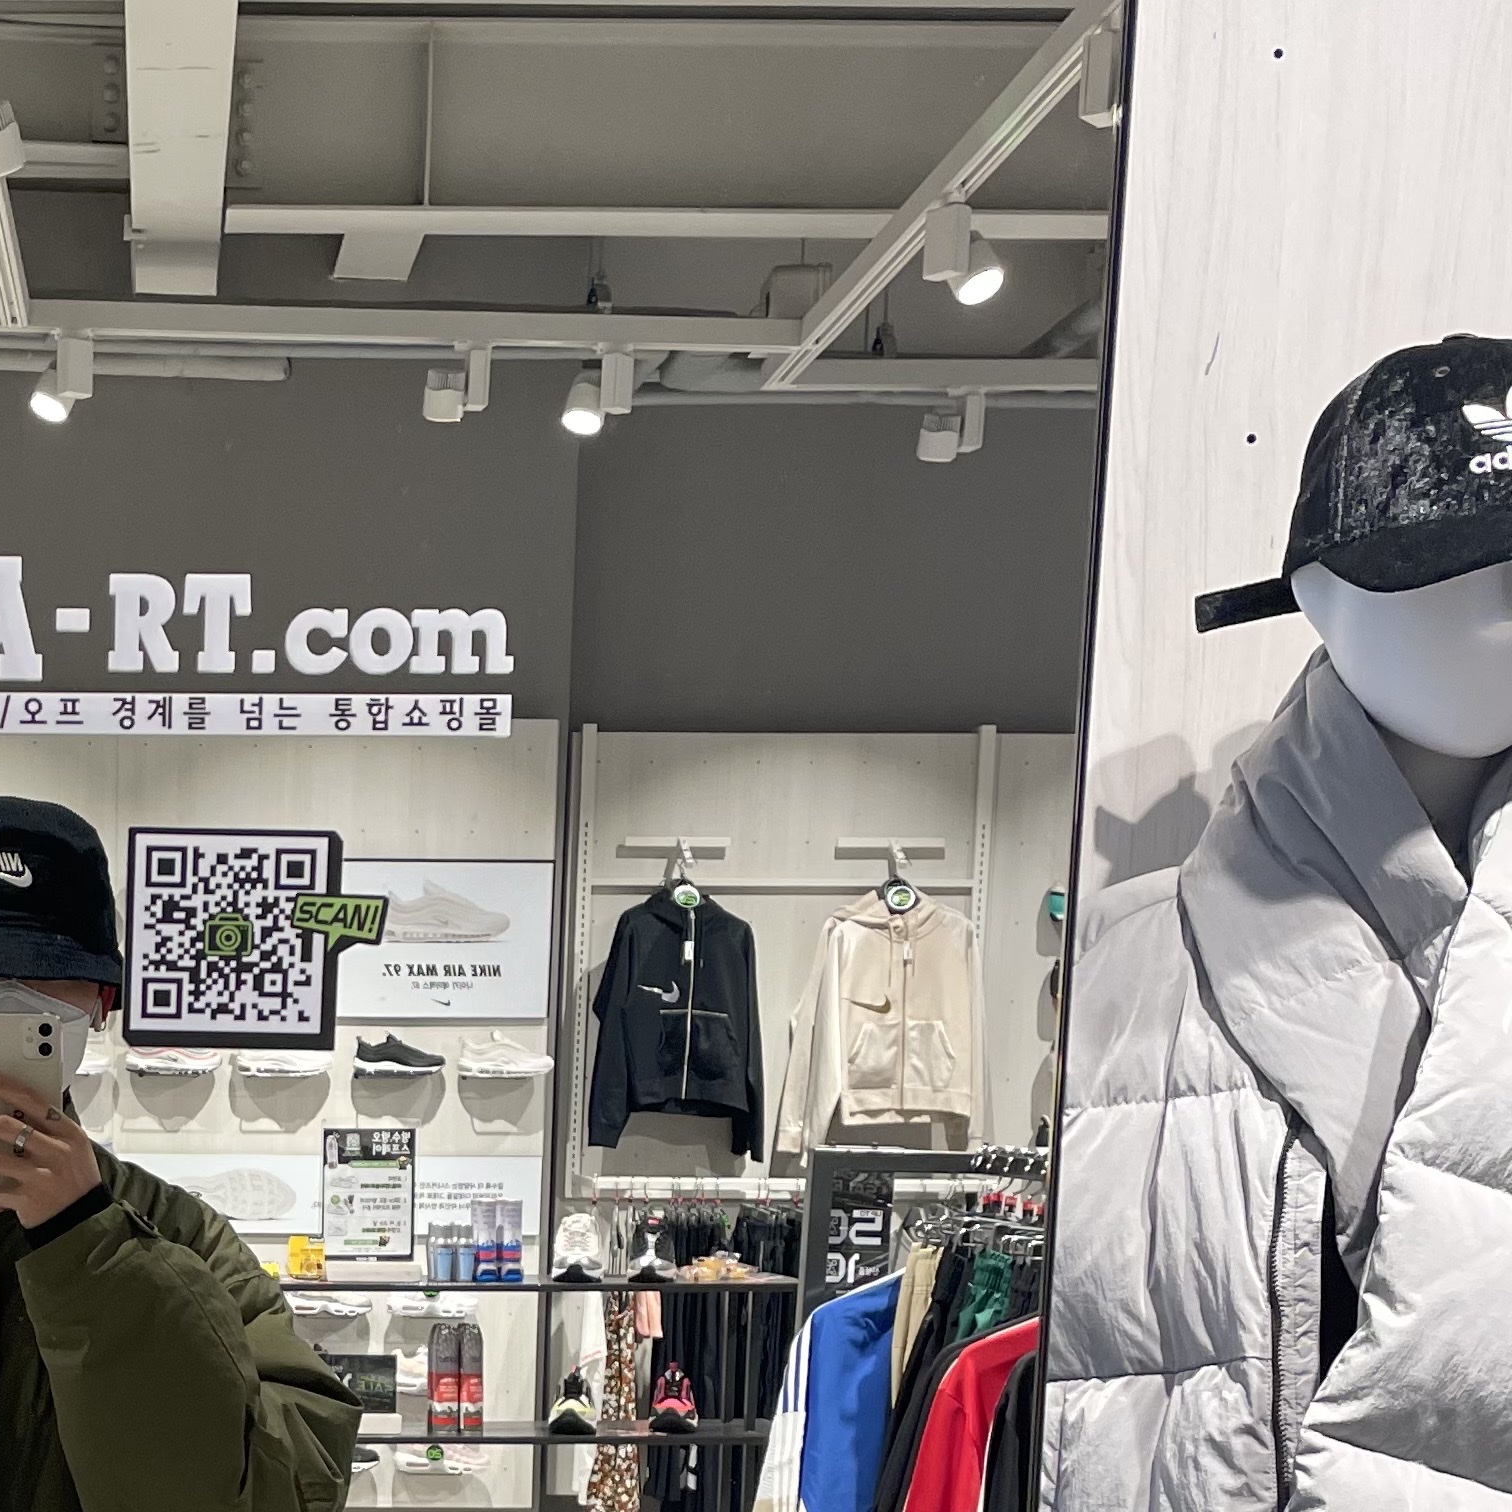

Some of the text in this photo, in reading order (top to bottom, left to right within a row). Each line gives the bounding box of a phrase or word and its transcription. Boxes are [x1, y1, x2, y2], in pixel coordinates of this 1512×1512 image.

[110, 696, 212, 730] 경계를
[239, 697, 302, 731] 넘는
[329, 697, 503, 732] 통합쇼핑몰
[295, 901, 380, 933] SCAN!
